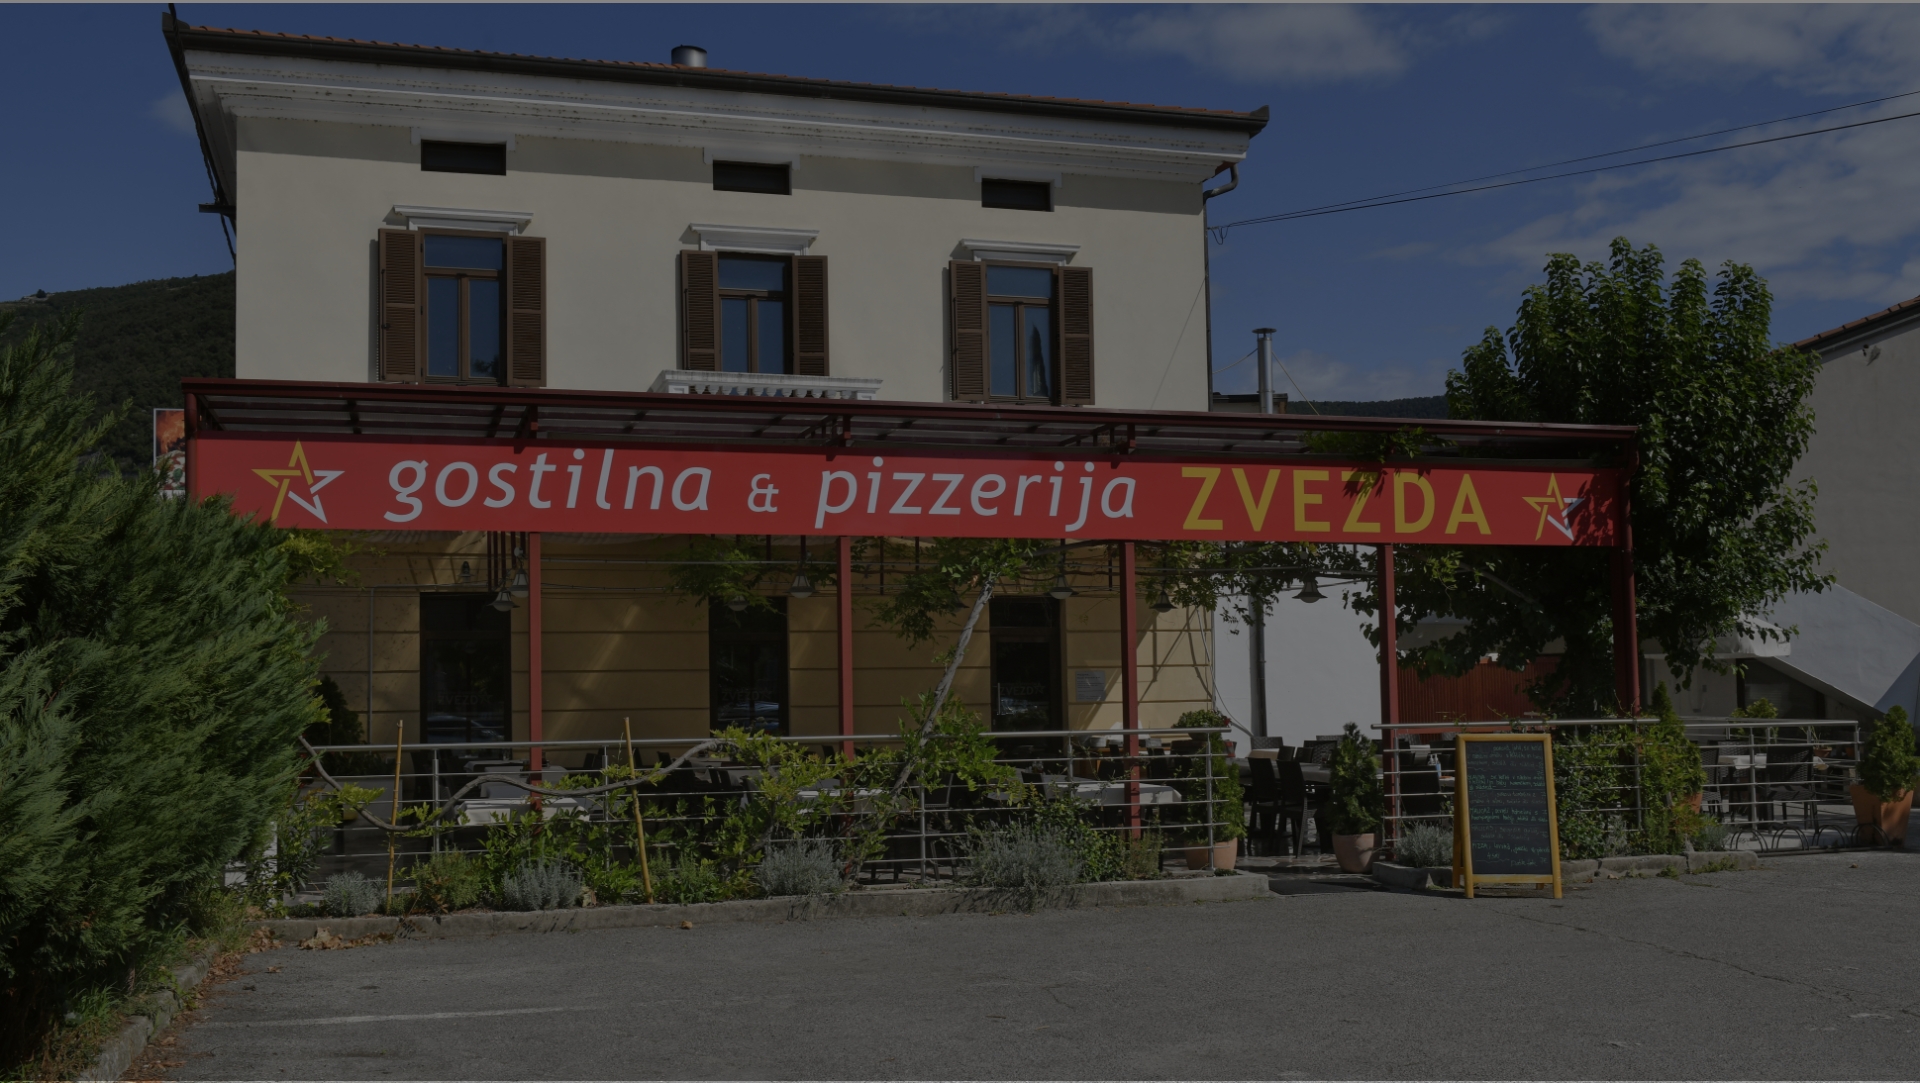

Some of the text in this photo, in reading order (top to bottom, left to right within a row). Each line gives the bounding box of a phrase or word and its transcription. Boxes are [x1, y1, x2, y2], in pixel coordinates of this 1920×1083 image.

[383, 447, 1492, 535] gostilna & pizzerija ZVEZDA
